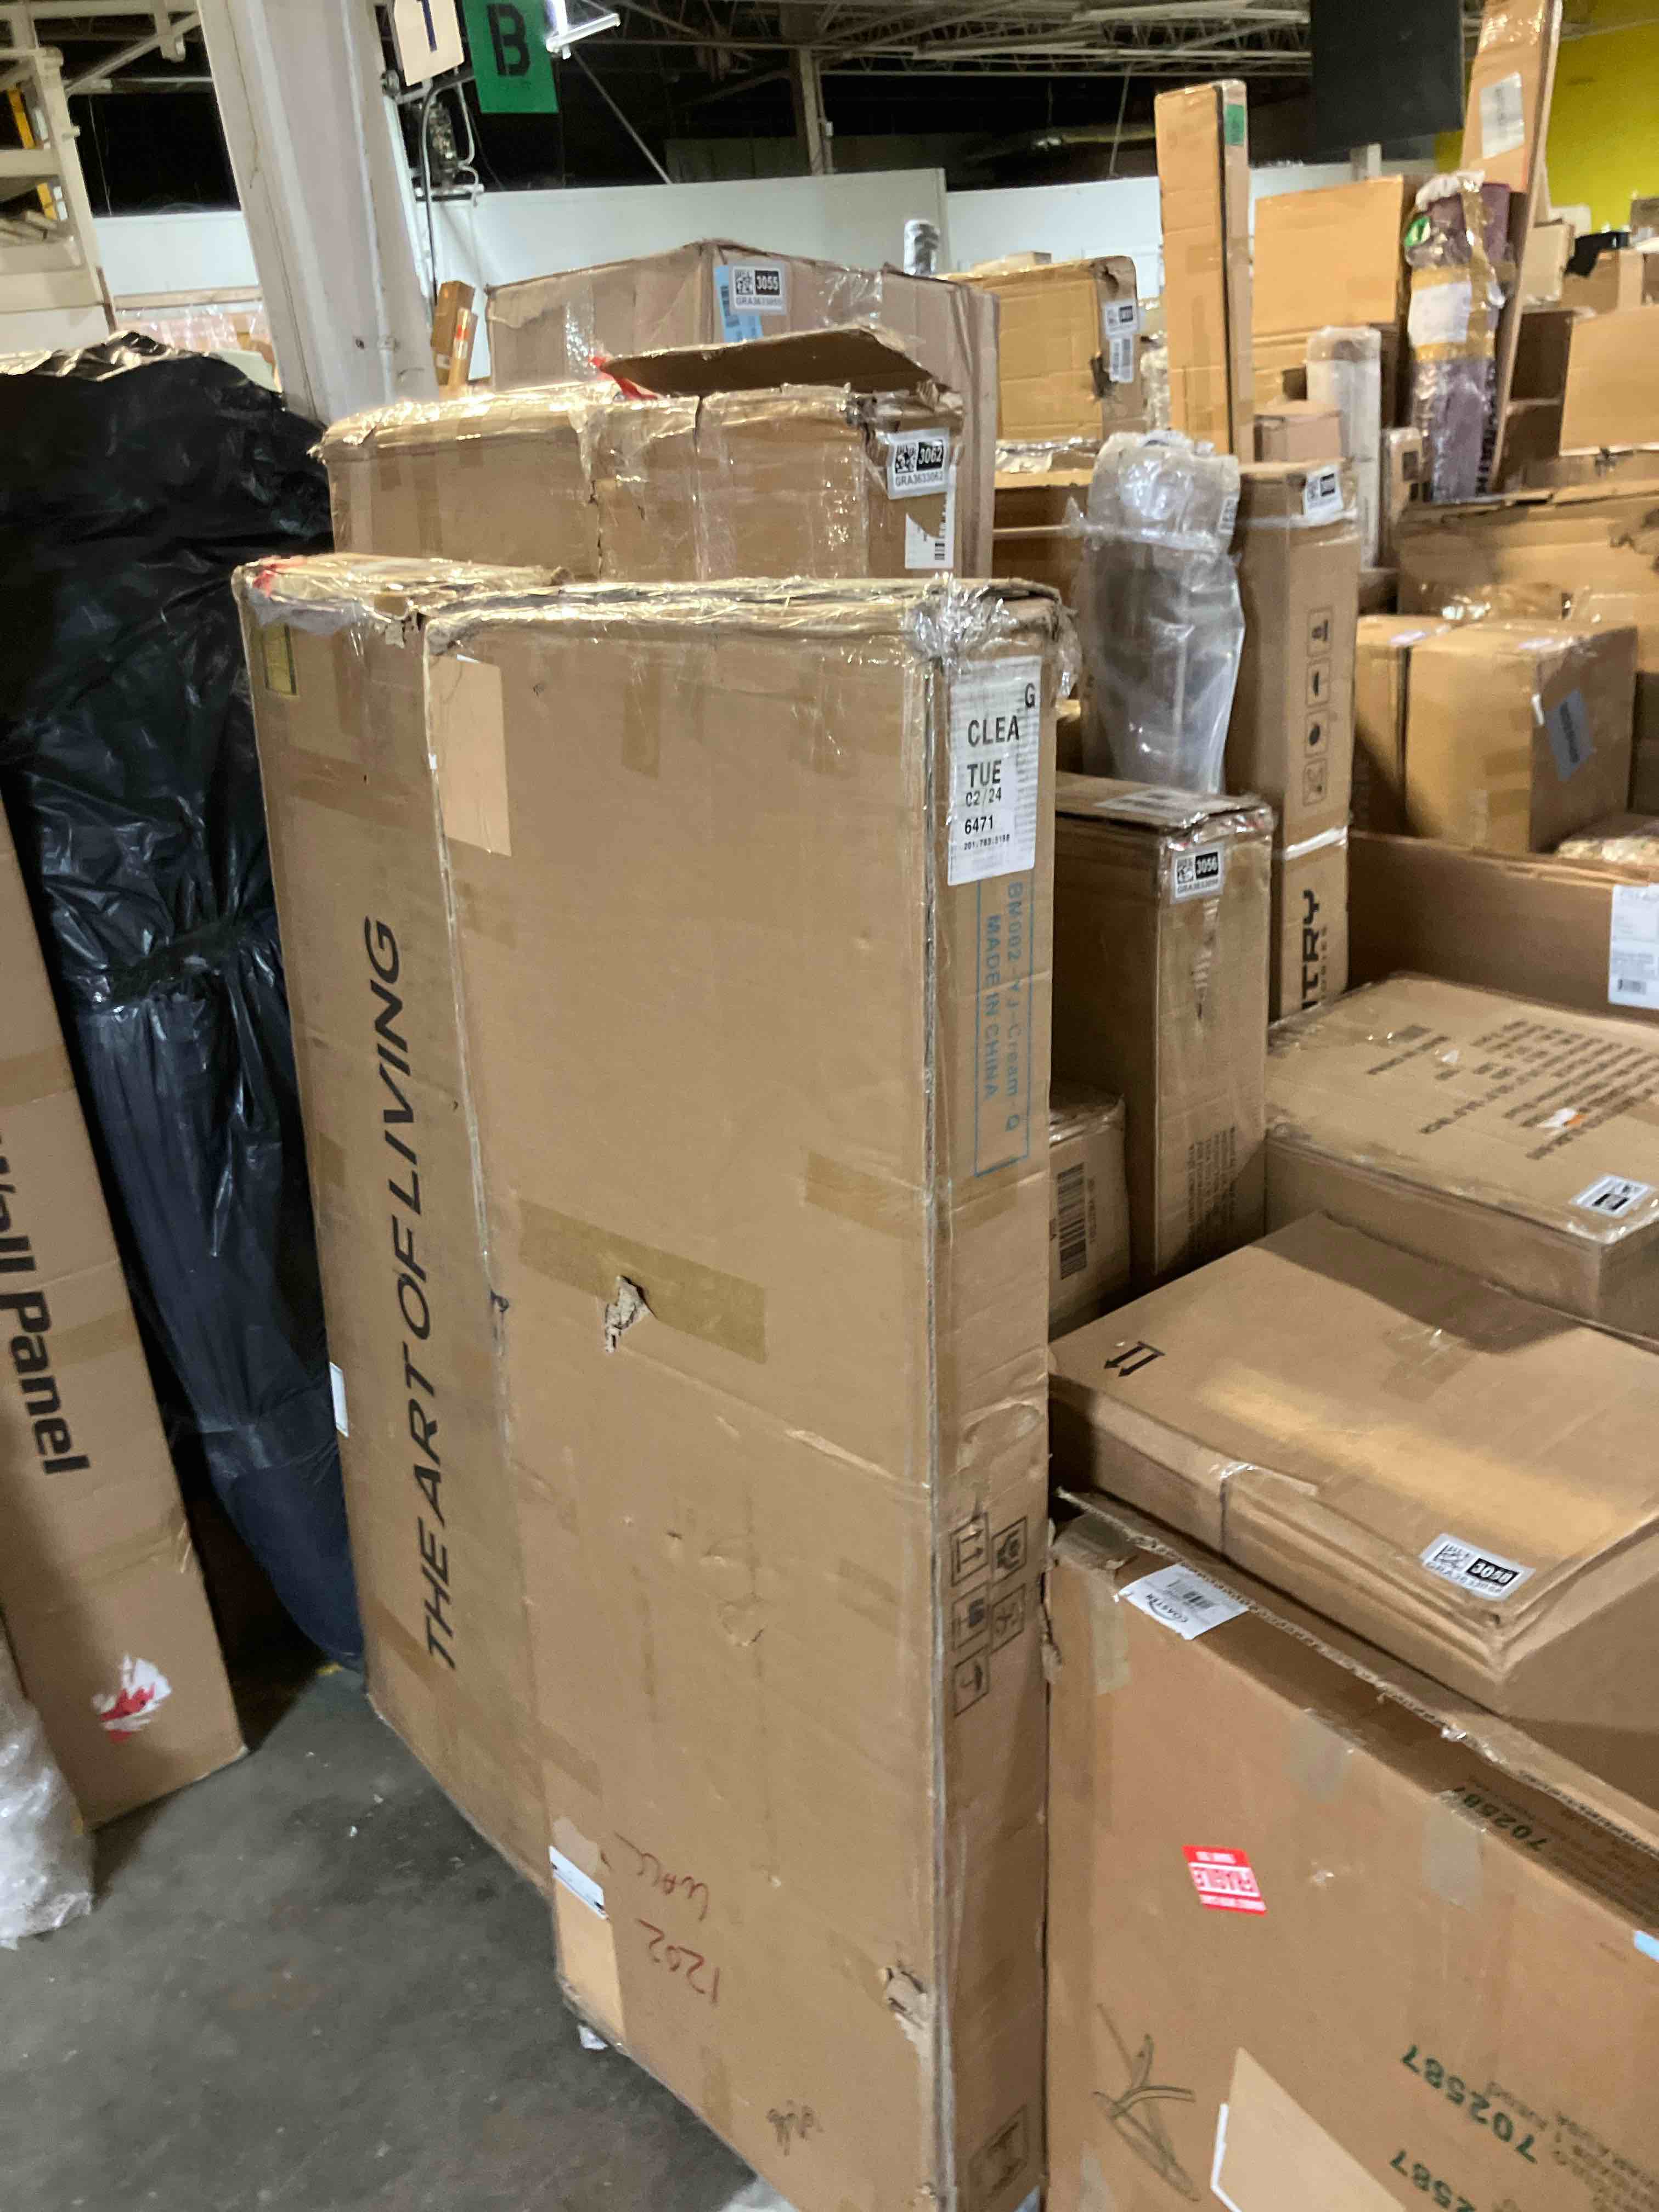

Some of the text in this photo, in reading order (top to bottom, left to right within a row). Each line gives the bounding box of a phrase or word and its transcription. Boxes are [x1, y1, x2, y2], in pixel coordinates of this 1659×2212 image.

[487, 3, 531, 76] B
[918, 445, 943, 465] 3062
[1024, 682, 1036, 709] G
[967, 715, 1020, 748] CLEA
[966, 759, 1002, 788] TUE
[964, 815, 994, 835] 6471
[984, 916, 1001, 985] MADE
[983, 1025, 1000, 1100] CHINA
[0, 1290, 91, 1476] Panel
[1401, 2044, 1538, 2164] 702587
[1390, 2149, 1476, 2212] 2587
